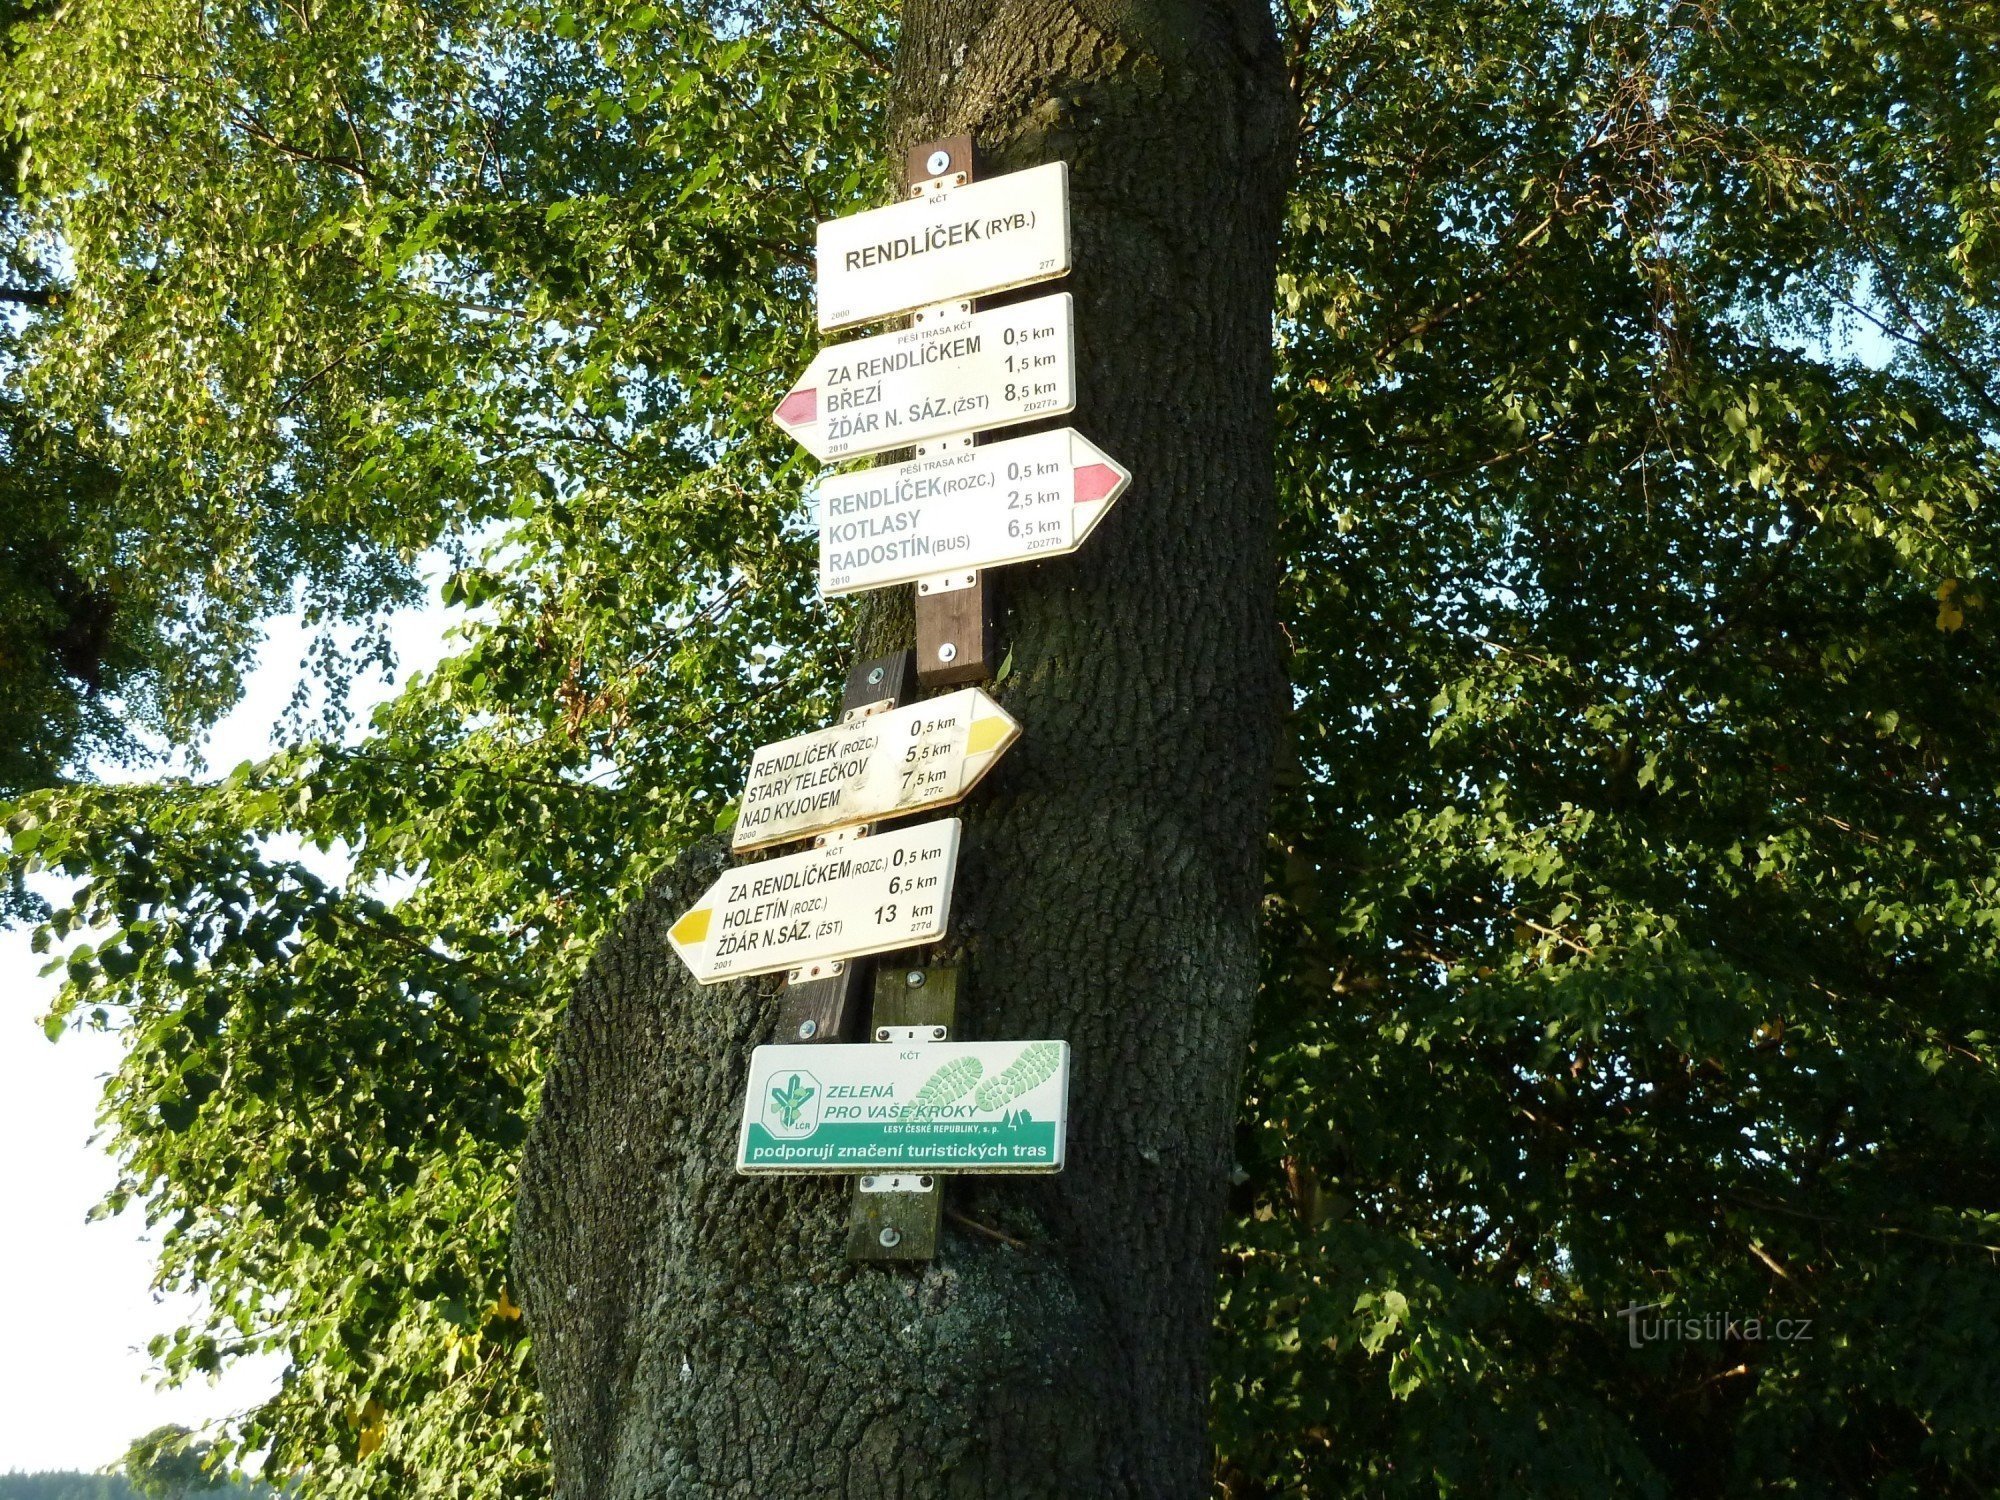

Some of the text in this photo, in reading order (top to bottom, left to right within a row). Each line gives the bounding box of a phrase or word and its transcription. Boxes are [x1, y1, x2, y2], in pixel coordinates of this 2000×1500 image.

[929, 193, 948, 204] KČT
[846, 211, 1036, 272] RENDLÍČEK (RYB.)
[1039, 259, 1055, 270] 277
[831, 310, 850, 320] 2000
[921, 326, 951, 339] TRASA
[953, 321, 972, 332] KČT
[828, 326, 1055, 386] ZA RENDLÍČKEM 0,5 km
[827, 354, 1056, 413] BŘEZÍ 1,5 km
[828, 382, 1056, 440] ŽĎÁR N. SÁZ. (ŽST) 8,5 km
[1023, 399, 1057, 412] ZD277a
[828, 443, 848, 453] 2010
[924, 457, 955, 471] TRASA
[957, 453, 976, 464] KČT
[829, 461, 1059, 517] RENDLÍČEK (ROZC.) 0,5 km
[829, 490, 1060, 544] KOTLASY 2,5 km
[829, 519, 1060, 572] RADOSTÍN (BUS) 6,5 km
[1027, 537, 1062, 550] ZD277b
[830, 575, 850, 586] 2010
[849, 720, 867, 730] KČT
[753, 716, 955, 779] RENDLÍČEK (ROZC.) 0,5 km
[748, 743, 951, 803] STARÝ TELEČKOV 5,5 km
[741, 770, 946, 828] NAD KYJOVEM 7,5 km
[924, 787, 943, 796] 277c
[738, 830, 756, 841] 2000
[825, 847, 843, 857] KČT
[728, 847, 941, 903] ZA RENDLÍČKEM (ROZC.) 0,5 km
[723, 876, 937, 929] HOLETÍN (ROZC.) 6,5 km
[716, 932, 758, 957] ŽĎÁR
[815, 920, 843, 940] (ŽST)
[874, 904, 897, 925] 13
[911, 904, 933, 917] km
[911, 921, 931, 932] 277d
[714, 960, 732, 970] 2001
[899, 1051, 920, 1060] KČT
[826, 1083, 895, 1098] ZELENÁ
[824, 1103, 978, 1118] PRO VAŠE KROKY
[884, 1125, 904, 1133] LESY
[905, 1123, 931, 1133] ČESKÉ
[933, 1125, 980, 1134] REPUBLIKY,
[754, 1142, 1047, 1160] podporují značení turistických tras
